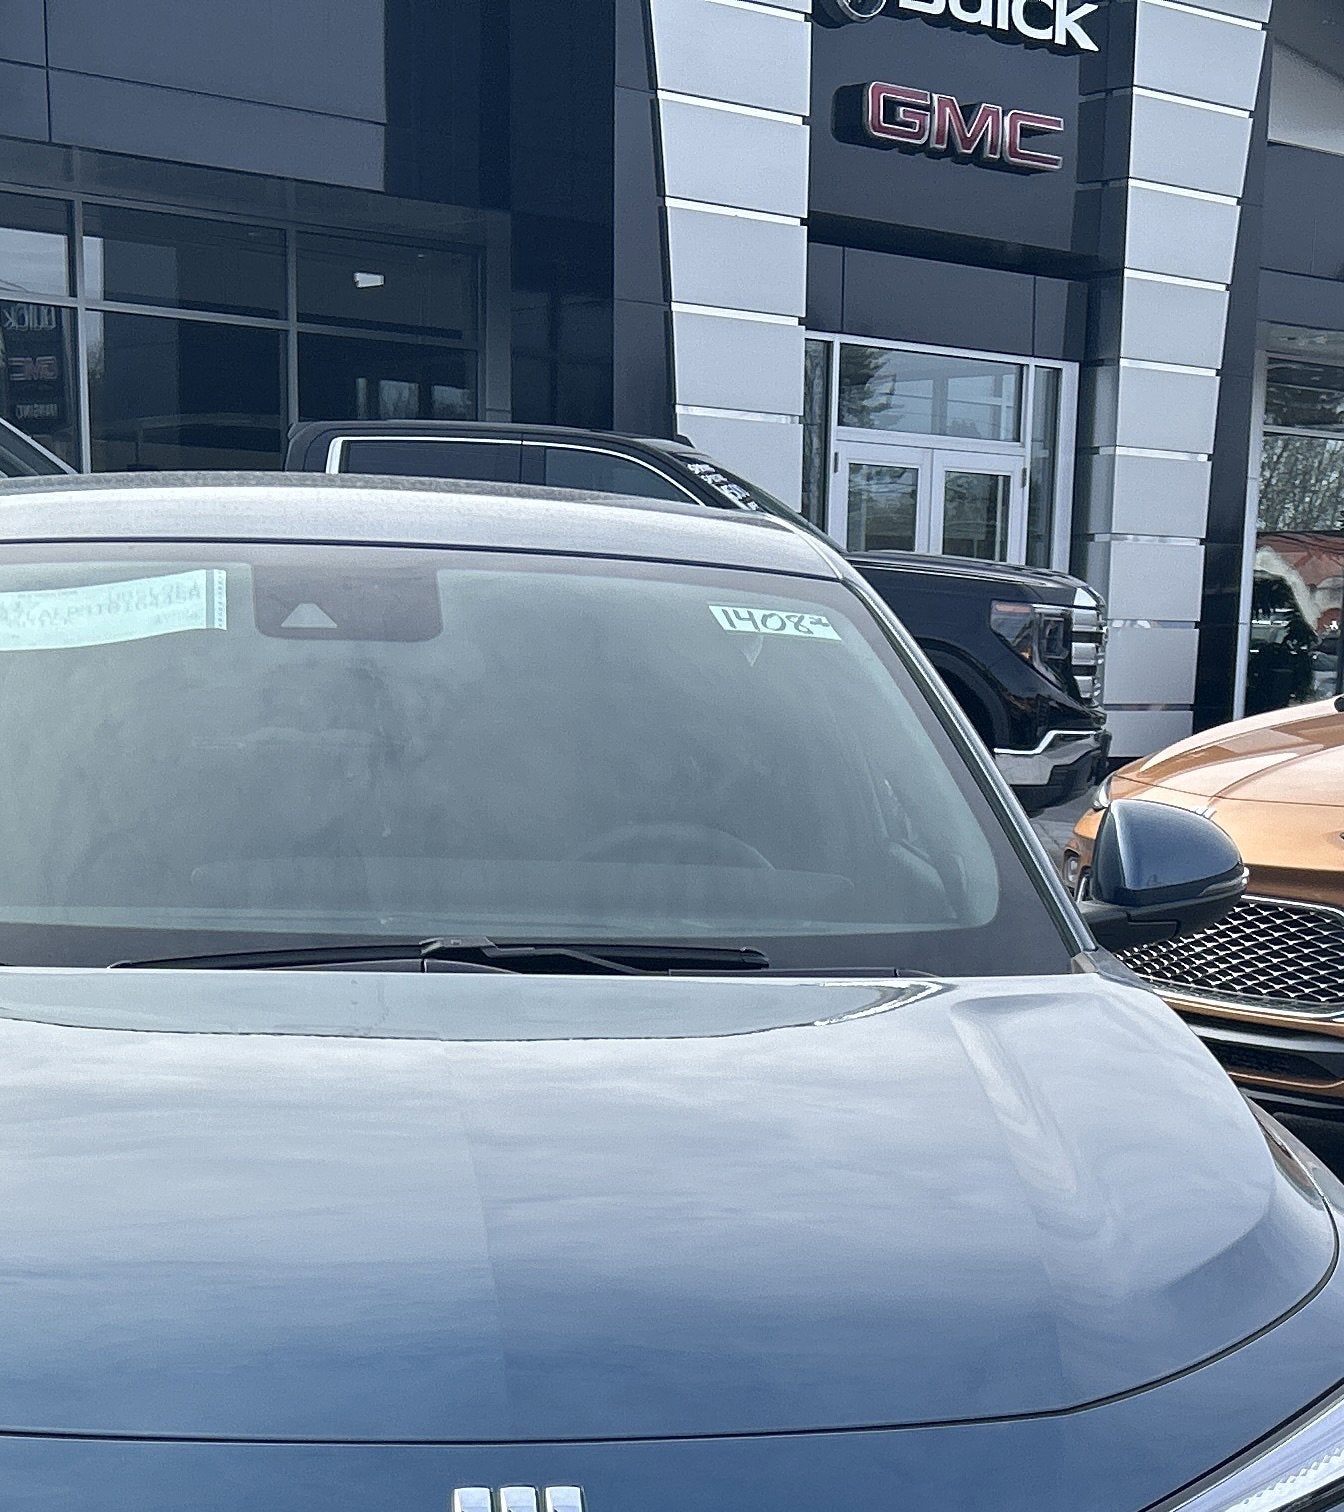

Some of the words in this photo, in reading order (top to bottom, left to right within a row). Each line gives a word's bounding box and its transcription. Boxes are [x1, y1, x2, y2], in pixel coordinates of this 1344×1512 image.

[899, 0, 1099, 51] uick
[867, 81, 1064, 170] GMC
[721, 608, 814, 635] 1408
